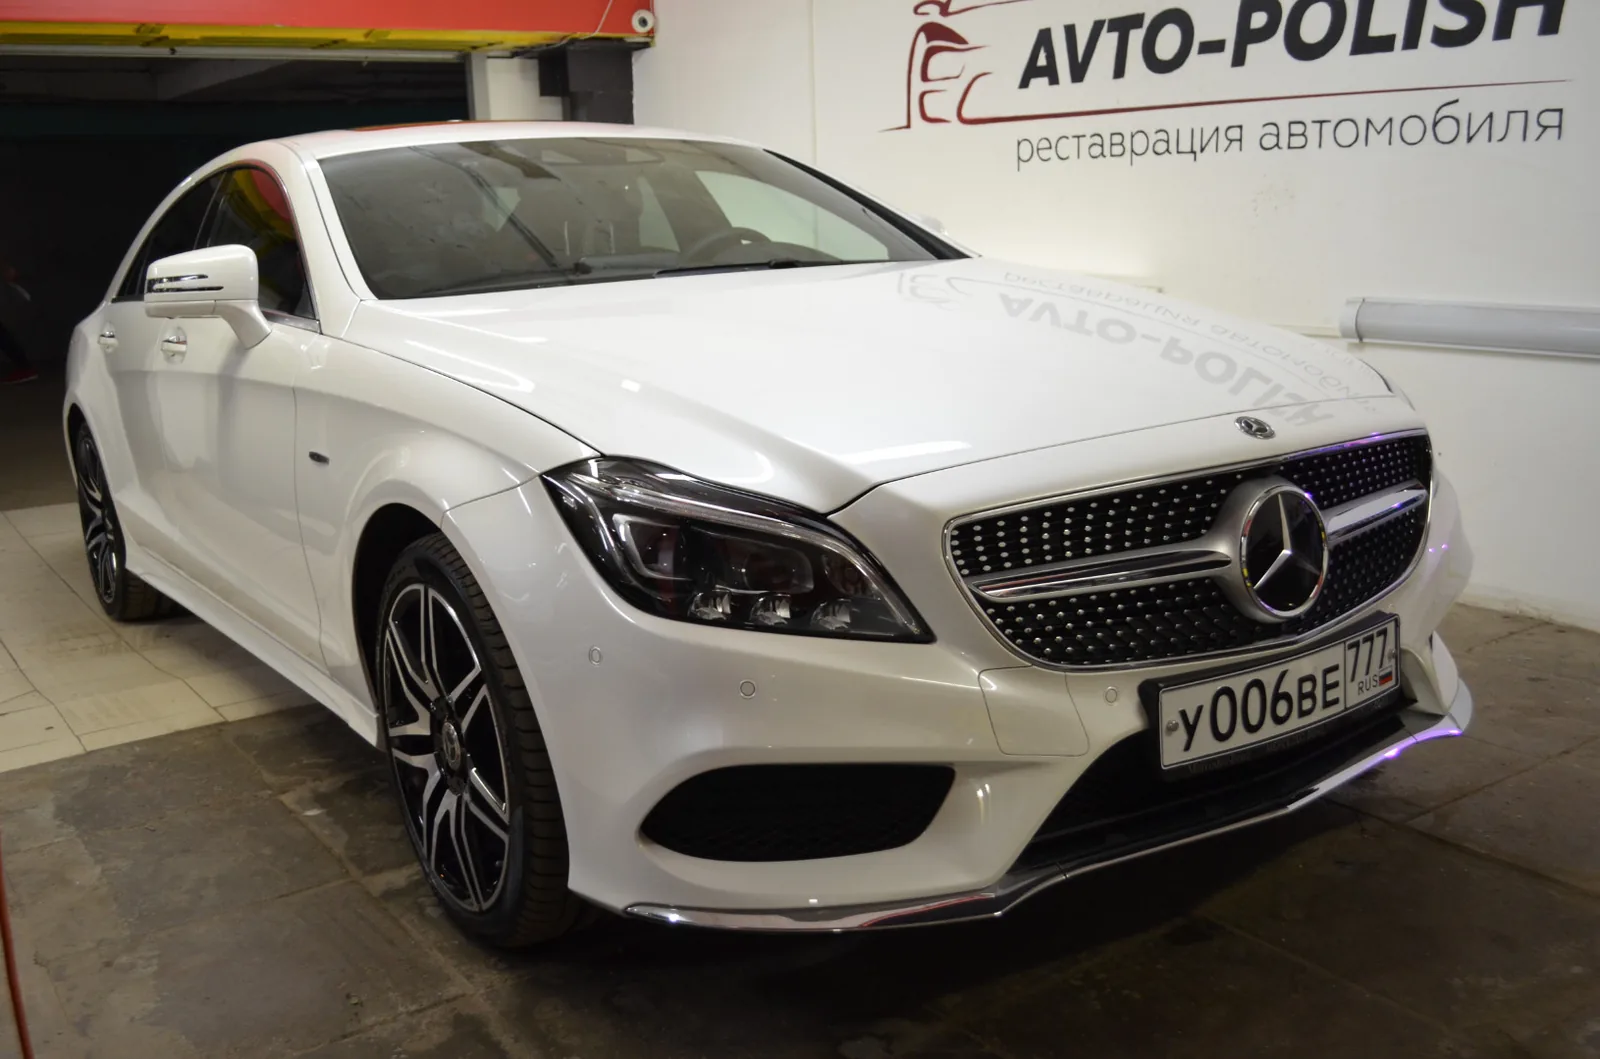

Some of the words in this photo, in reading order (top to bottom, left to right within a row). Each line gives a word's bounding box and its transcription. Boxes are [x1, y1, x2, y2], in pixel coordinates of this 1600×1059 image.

[1017, 124, 1244, 172] реставрация
[1259, 98, 1564, 152] автомобиля
[1347, 627, 1388, 683] 777
[1358, 674, 1378, 695] RUS
